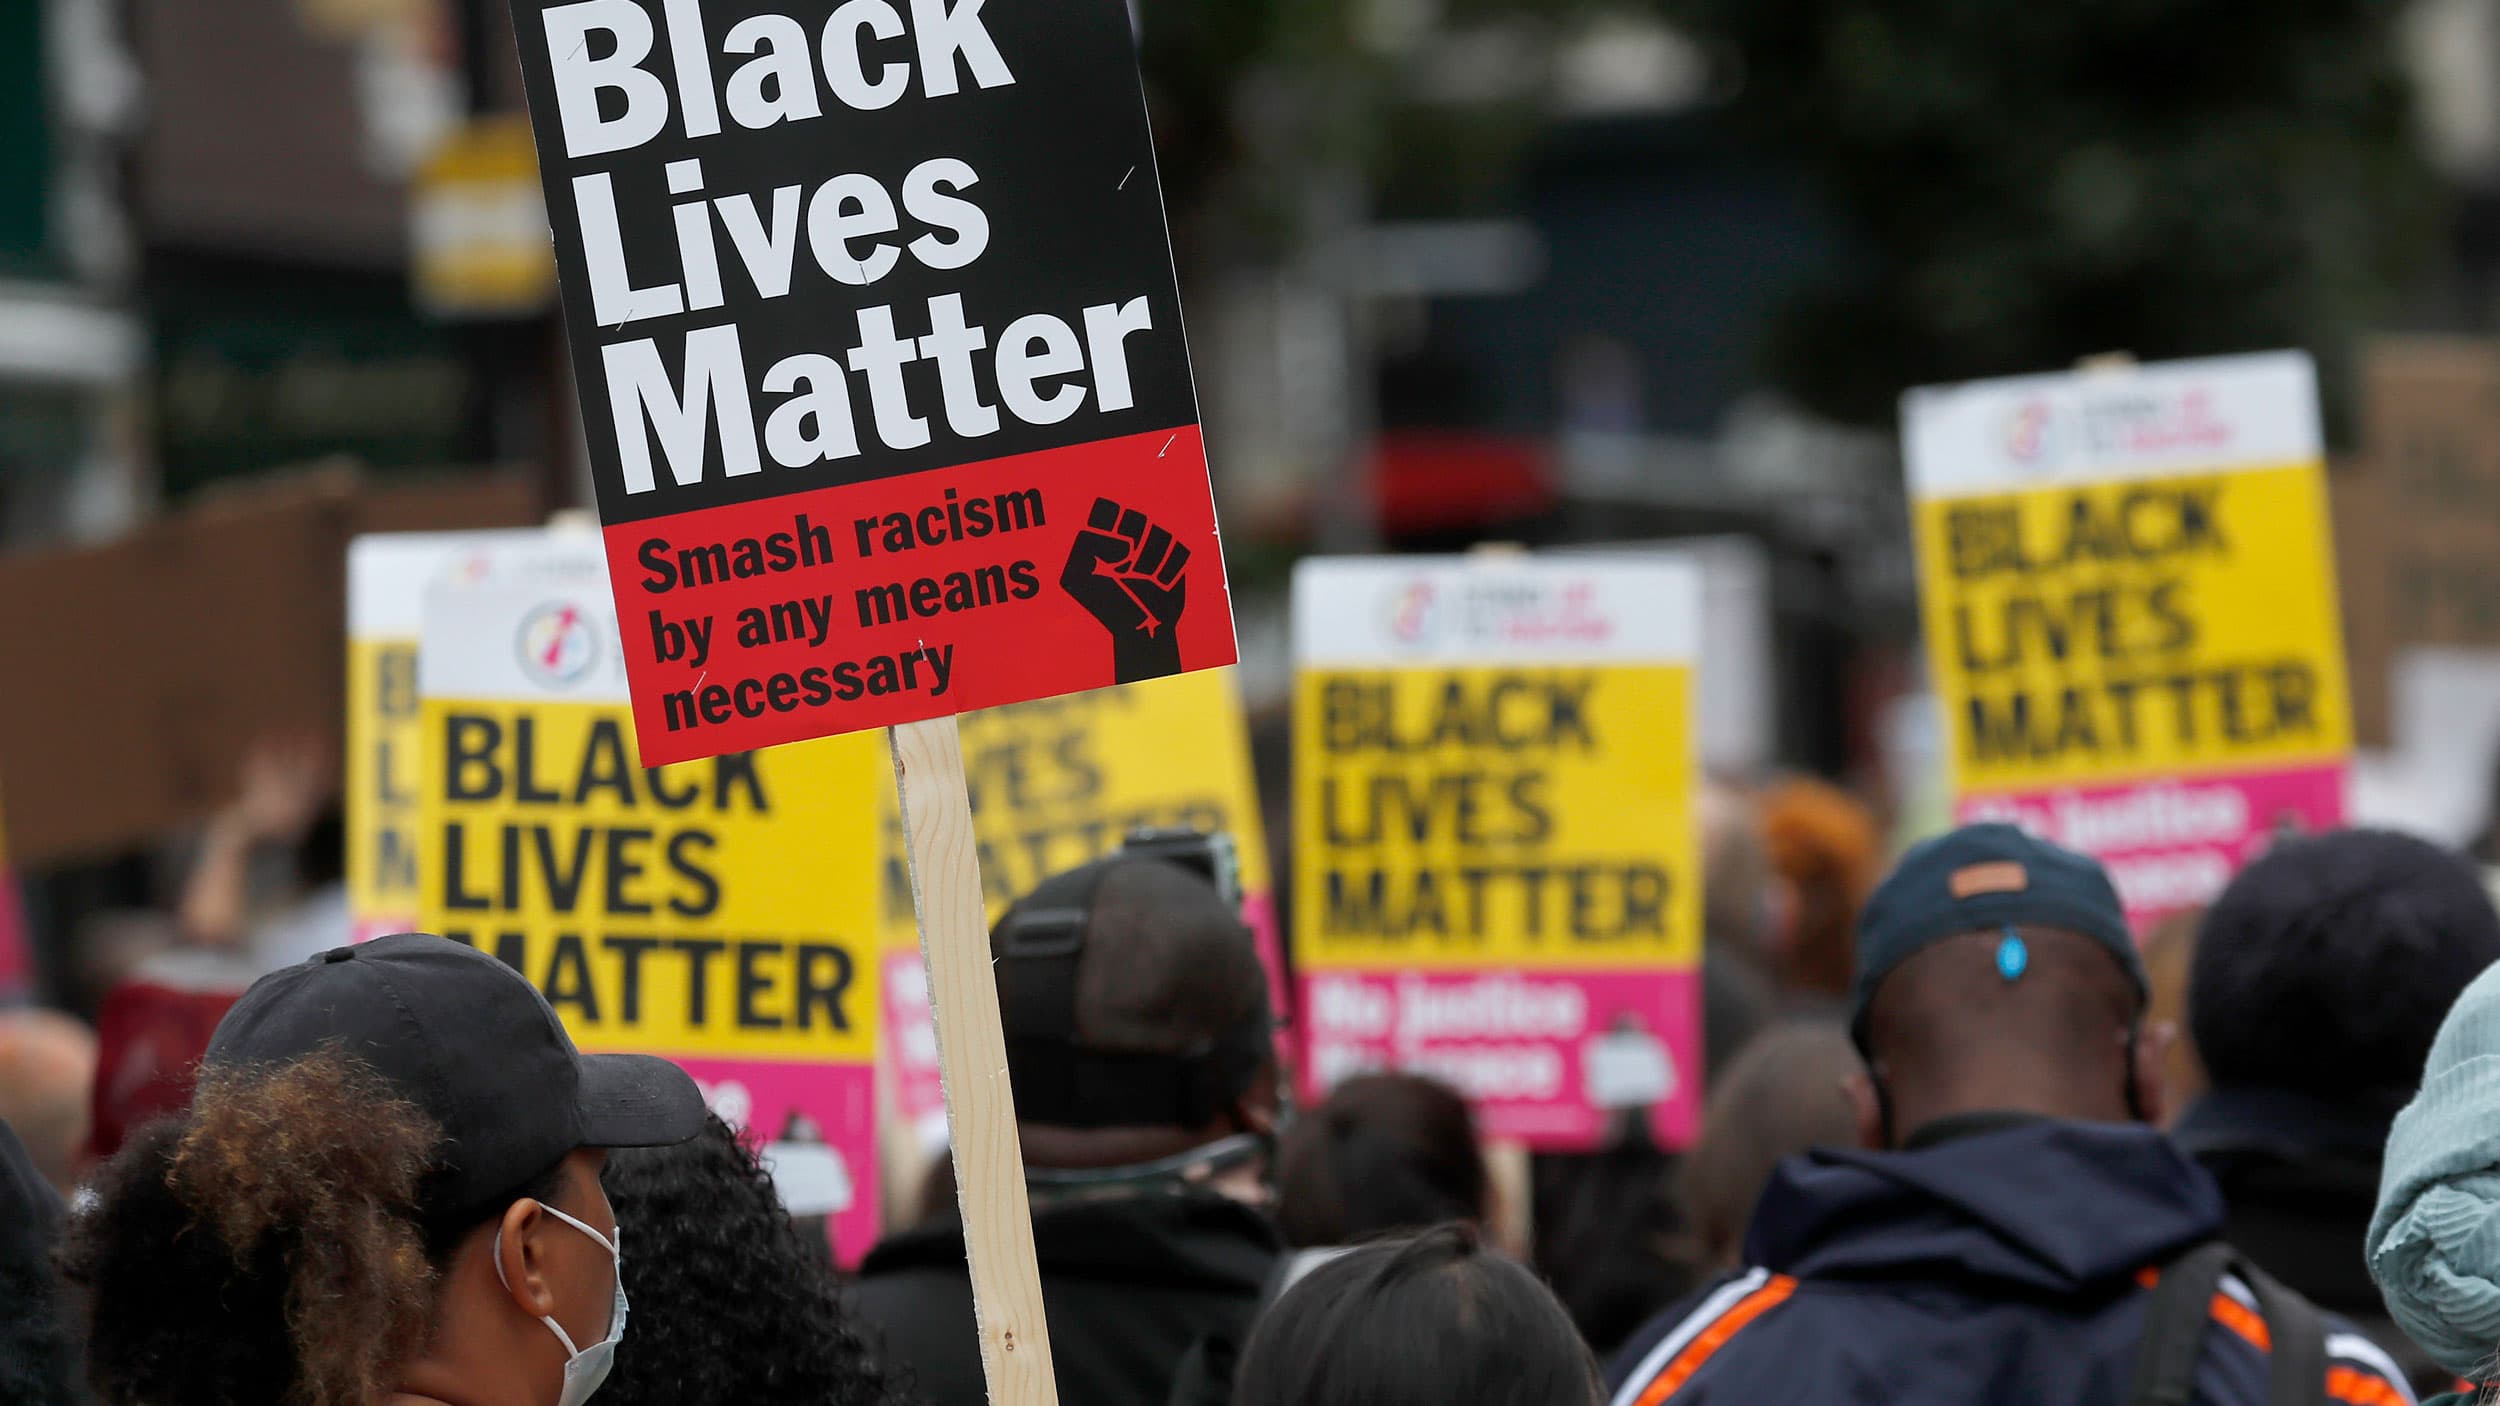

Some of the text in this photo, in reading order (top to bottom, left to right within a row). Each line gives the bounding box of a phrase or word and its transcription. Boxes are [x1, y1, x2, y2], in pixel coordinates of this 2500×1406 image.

[541, 0, 1016, 158] Black
[572, 158, 990, 328] Lives
[601, 292, 1153, 496] Matter
[637, 515, 834, 594] Smash
[854, 487, 1047, 559] racism
[1942, 482, 2232, 580] BLACK
[648, 559, 1041, 668] by any means
[1955, 577, 2202, 676] LIVES
[662, 643, 954, 733] necessary
[1321, 674, 1598, 757] BLACK
[1967, 657, 2320, 765] MATTER
[1321, 769, 1555, 848] LIVES
[443, 820, 723, 917] LIVES
[1321, 860, 1673, 944] MATTER
